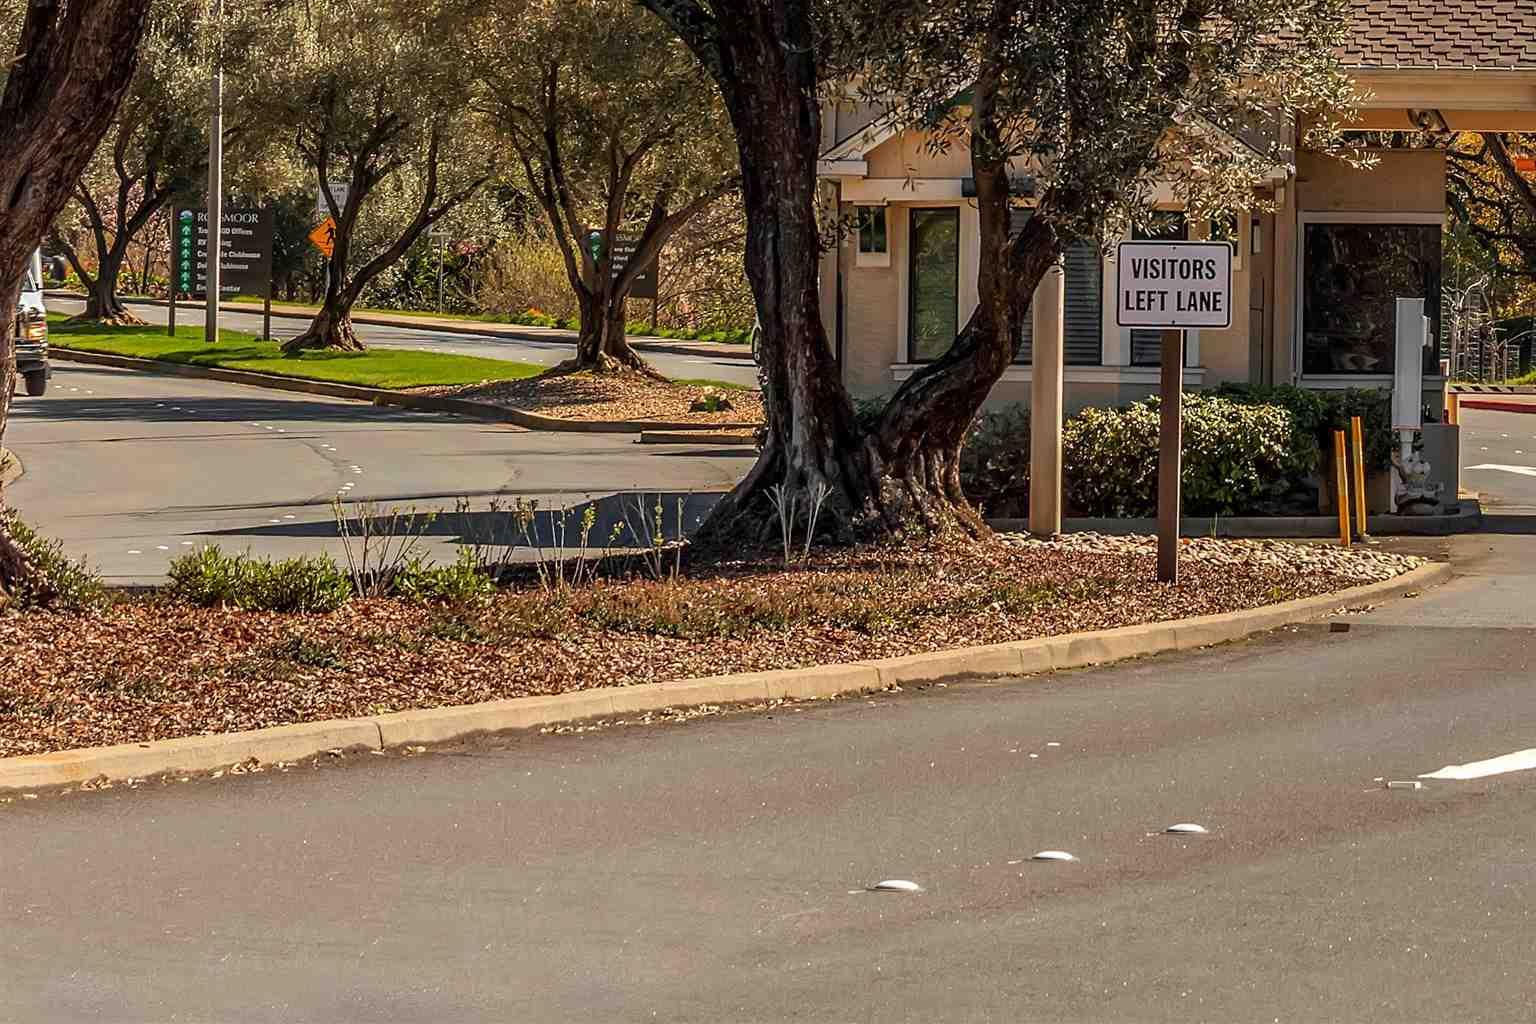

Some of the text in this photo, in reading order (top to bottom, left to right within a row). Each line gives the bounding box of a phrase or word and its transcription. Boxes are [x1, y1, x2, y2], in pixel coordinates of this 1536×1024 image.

[1131, 258, 1216, 280] VISITORS
[1125, 289, 1222, 312] LEFT LANE
